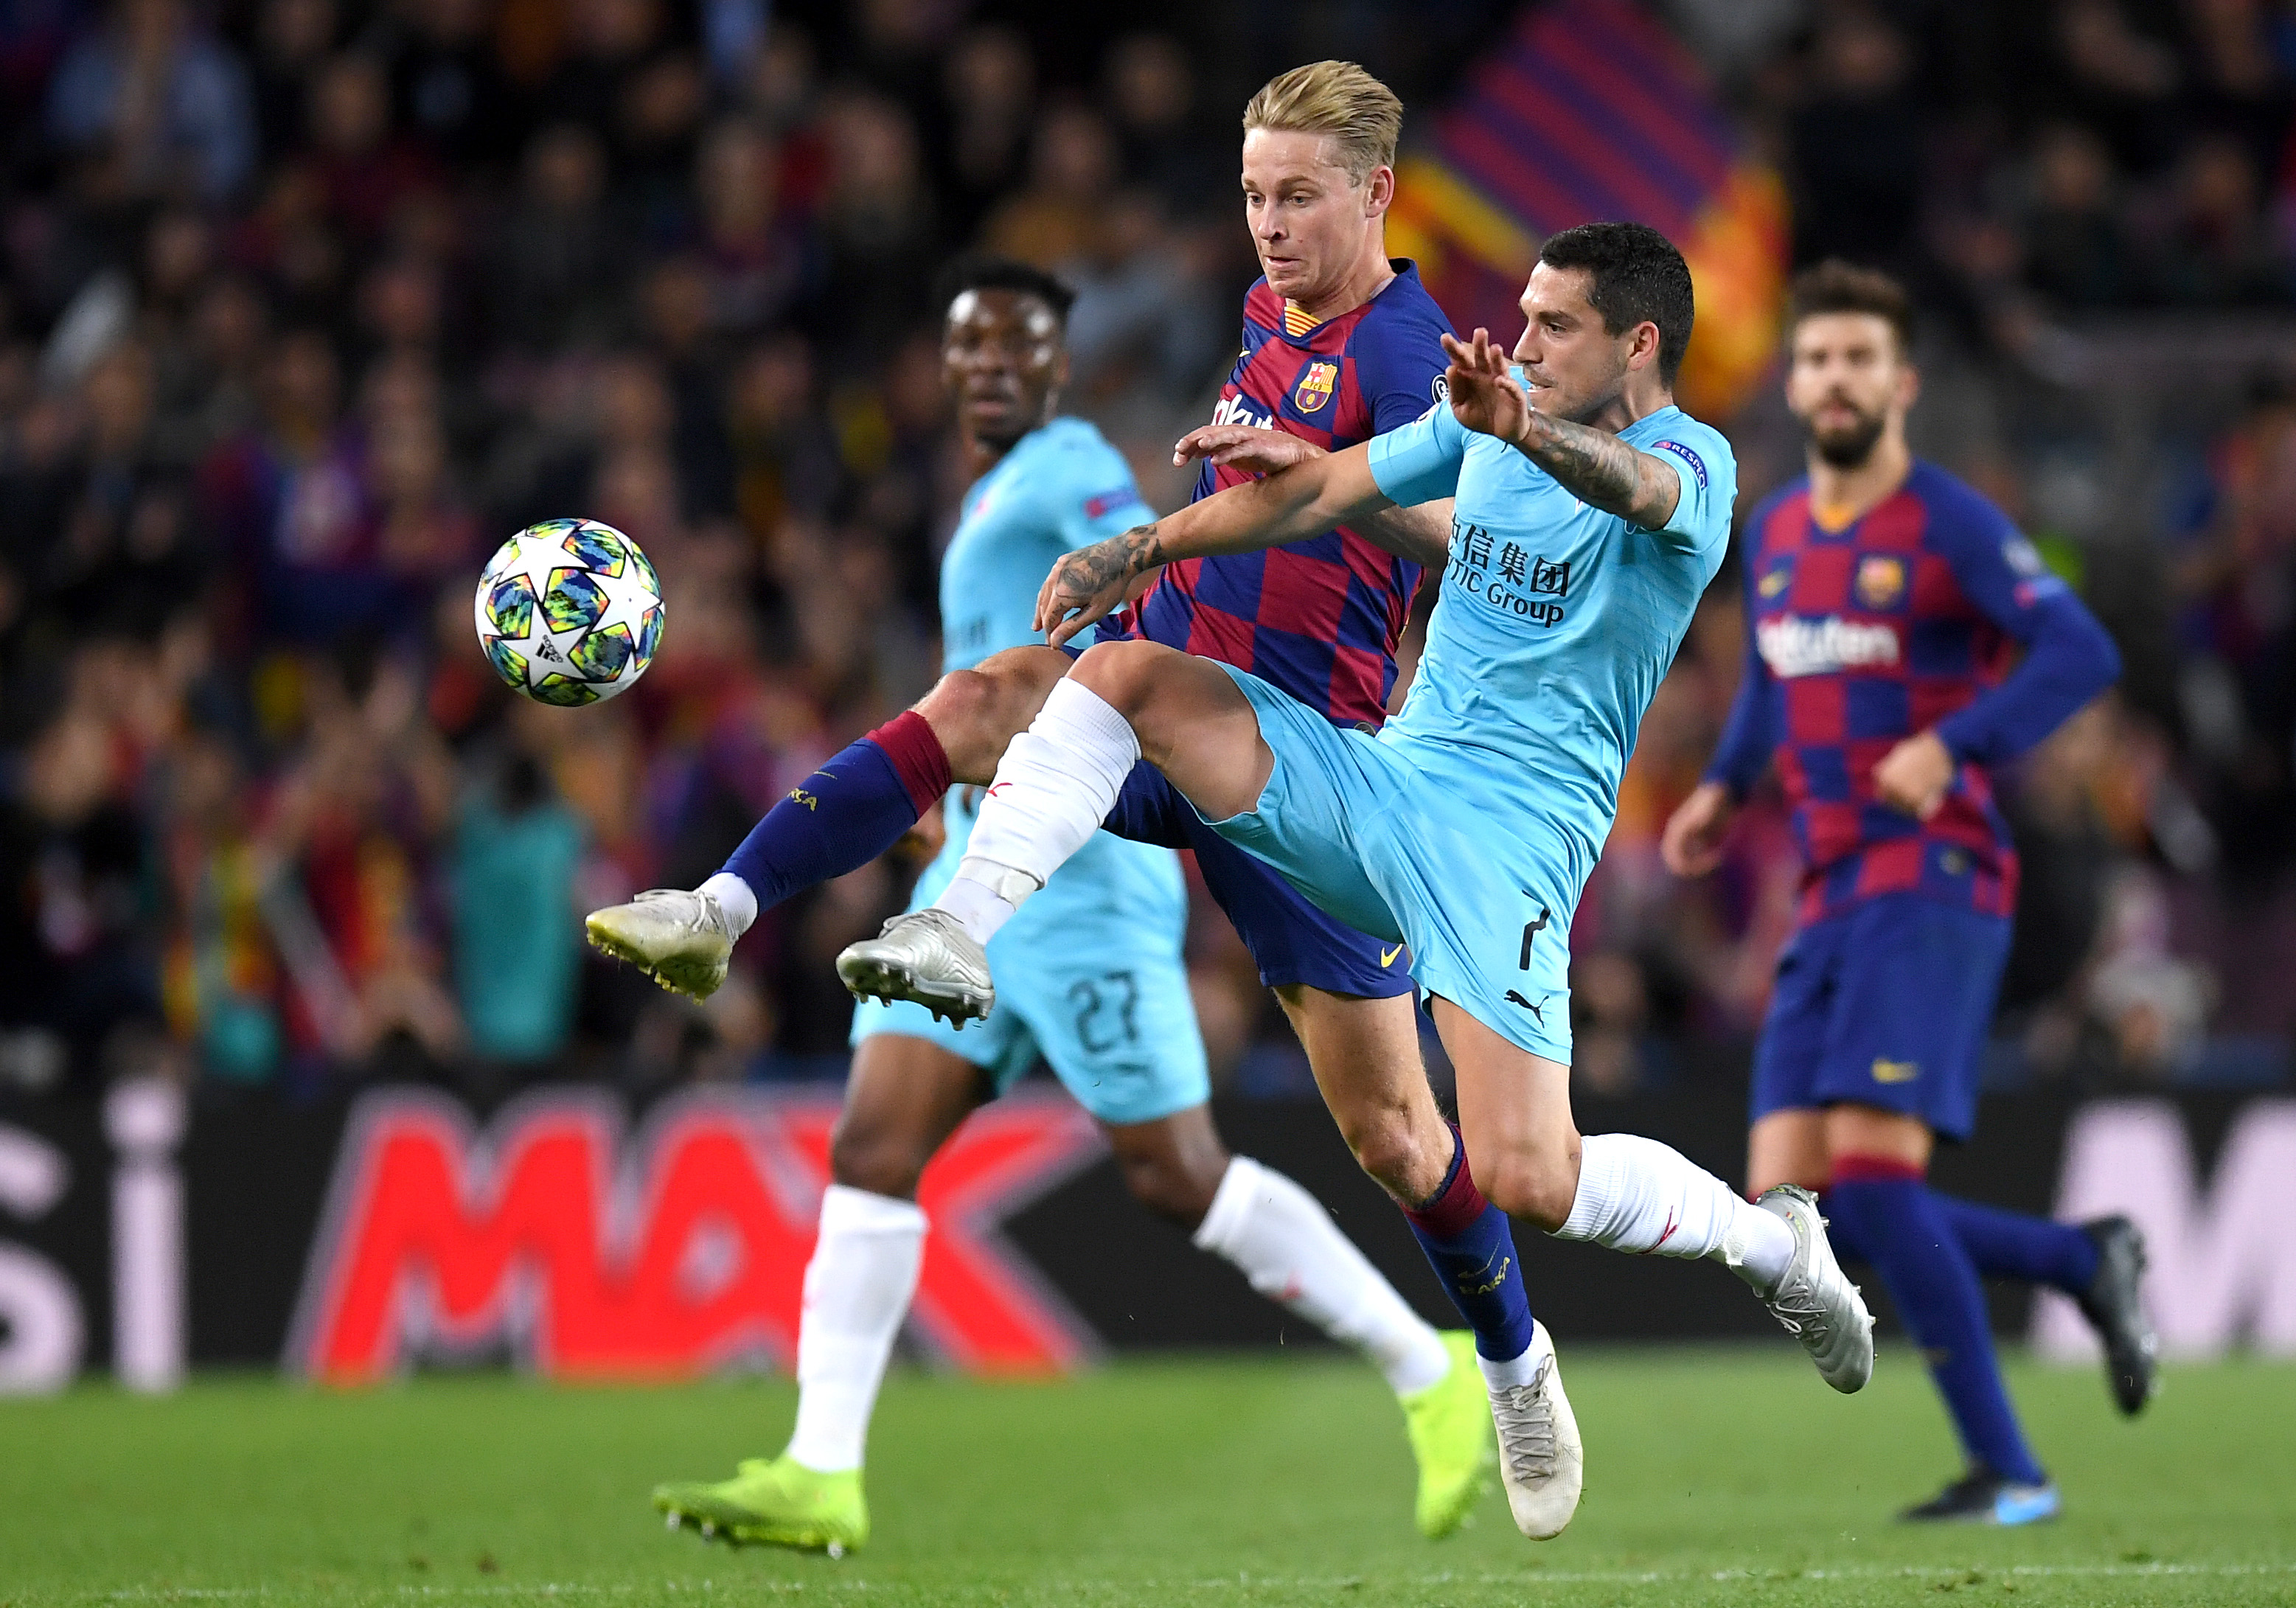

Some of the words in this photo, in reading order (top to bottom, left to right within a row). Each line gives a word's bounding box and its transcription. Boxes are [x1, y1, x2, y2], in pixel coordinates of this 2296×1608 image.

[1671, 444, 1706, 490] RESPEC
[1448, 557, 1483, 593] TIC
[1486, 582, 1565, 628] Group
[541, 634, 564, 664] adidas
[1067, 968, 1140, 1055] 27
[295, 1091, 1106, 1388] MAX
